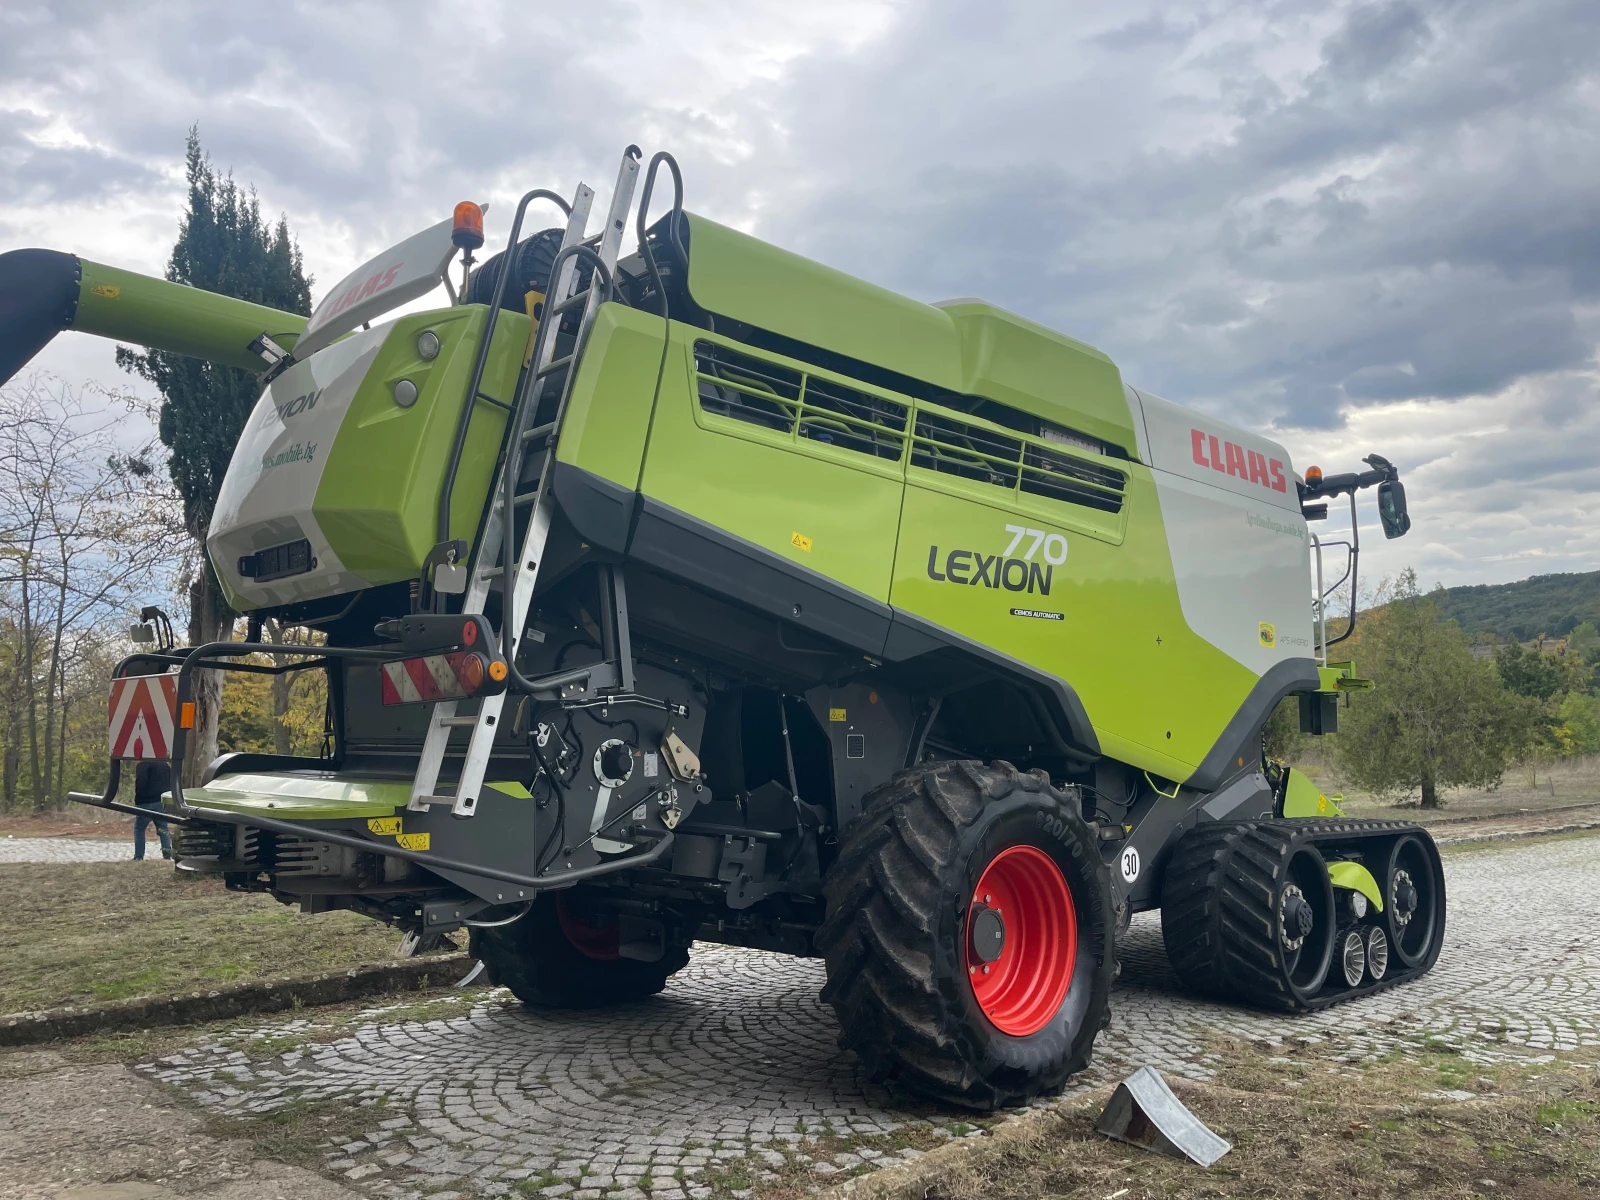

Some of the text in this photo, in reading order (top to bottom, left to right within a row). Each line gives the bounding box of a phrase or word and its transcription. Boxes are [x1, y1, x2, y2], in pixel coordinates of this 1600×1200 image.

[317, 262, 404, 326] CLAAS
[1191, 429, 1286, 493] CLAAS
[1003, 524, 1068, 565] 770
[927, 545, 1052, 596] LEXION
[1014, 609, 1061, 620] CEMOS AUTOMATIC
[1124, 853, 1137, 876] 30
